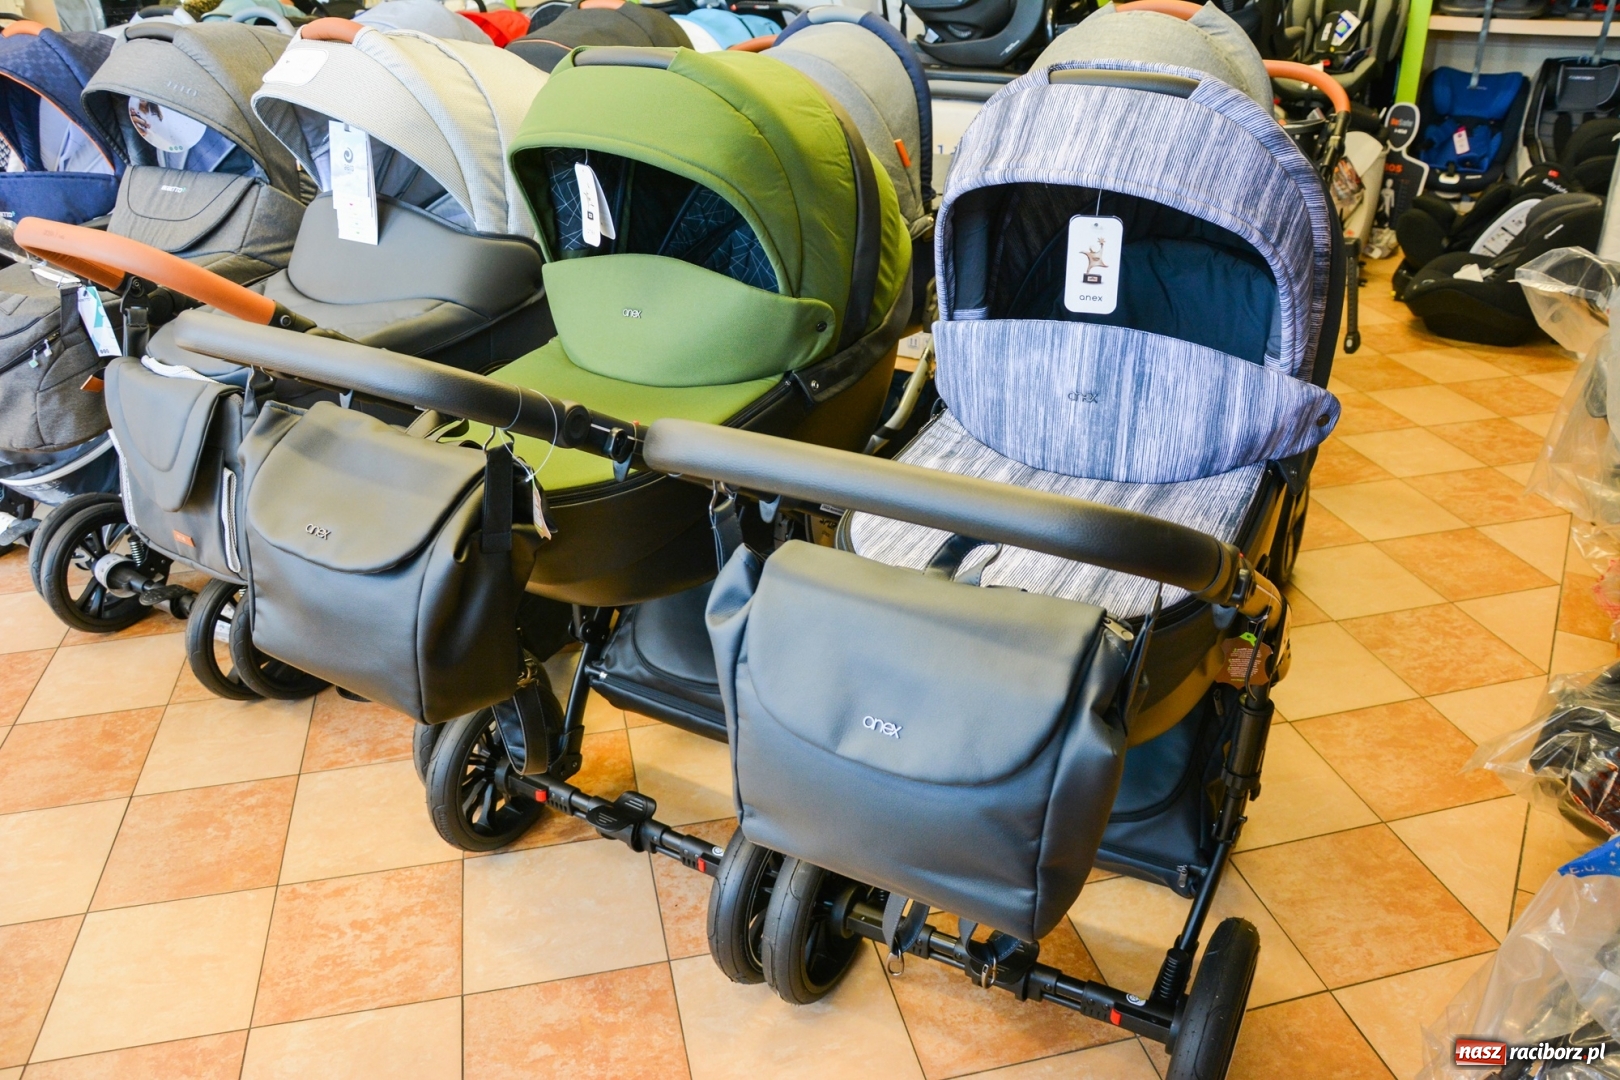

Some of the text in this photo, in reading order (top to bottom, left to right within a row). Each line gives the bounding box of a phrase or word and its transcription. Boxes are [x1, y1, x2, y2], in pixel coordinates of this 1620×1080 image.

[1079, 294, 1103, 302] anex
[622, 308, 642, 319] anex
[1068, 391, 1099, 404] anex
[305, 523, 332, 541] anex
[862, 715, 904, 739] anex
